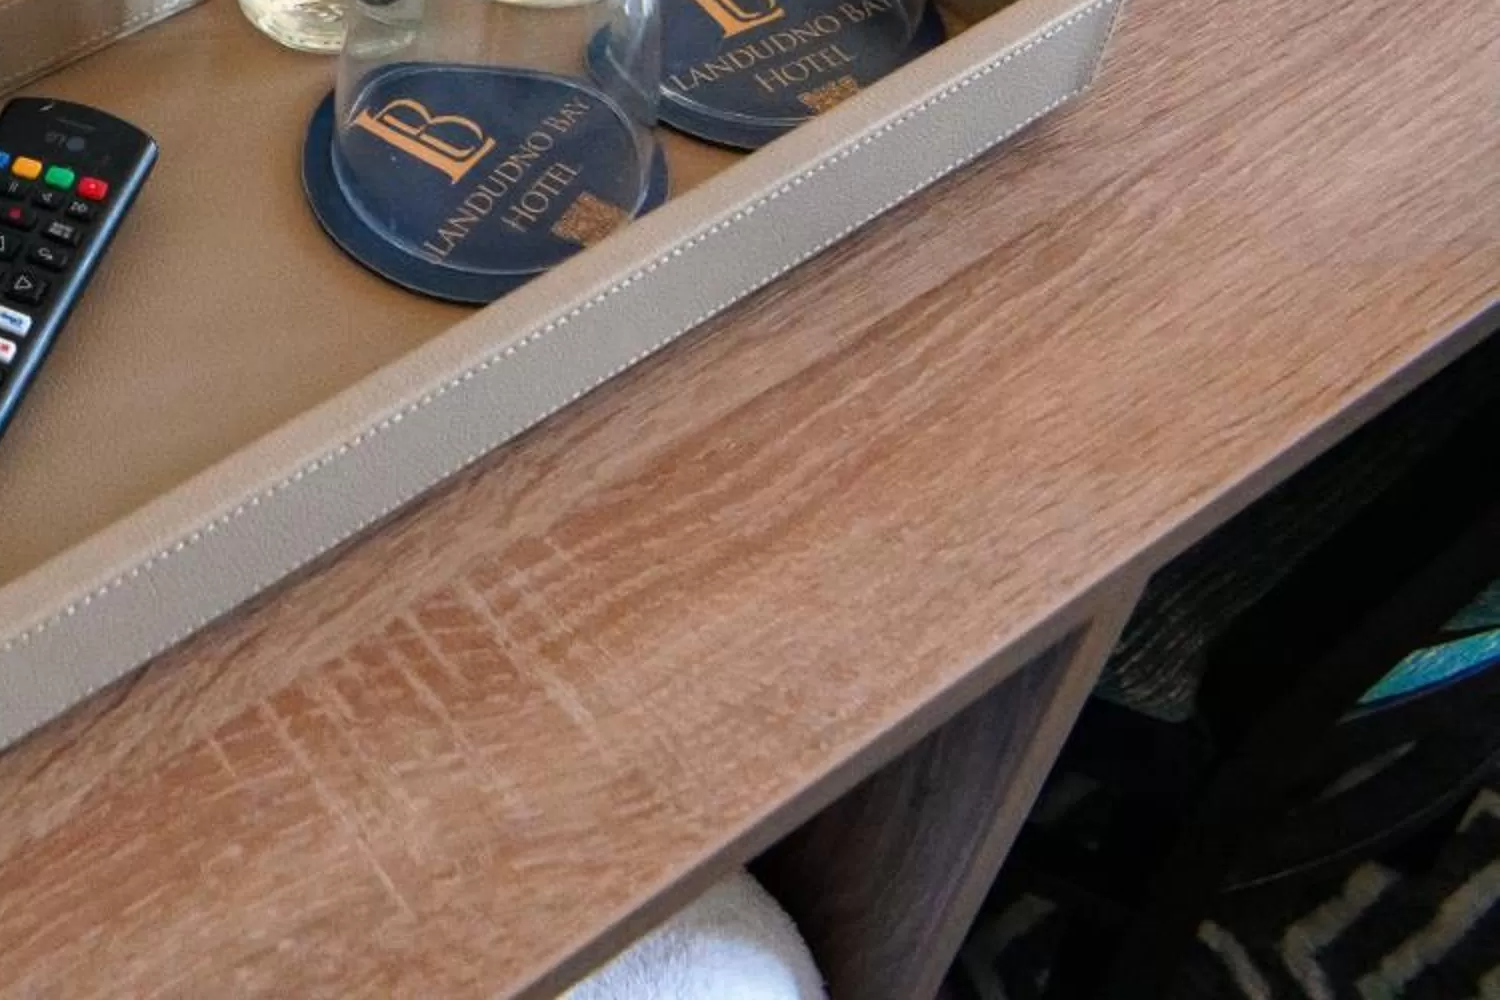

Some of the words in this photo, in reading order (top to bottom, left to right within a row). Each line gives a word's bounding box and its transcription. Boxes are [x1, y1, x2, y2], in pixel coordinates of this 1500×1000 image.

[754, 43, 857, 93] HOTEL
[543, 94, 592, 134] BAY
[502, 161, 585, 234] HOTEL
